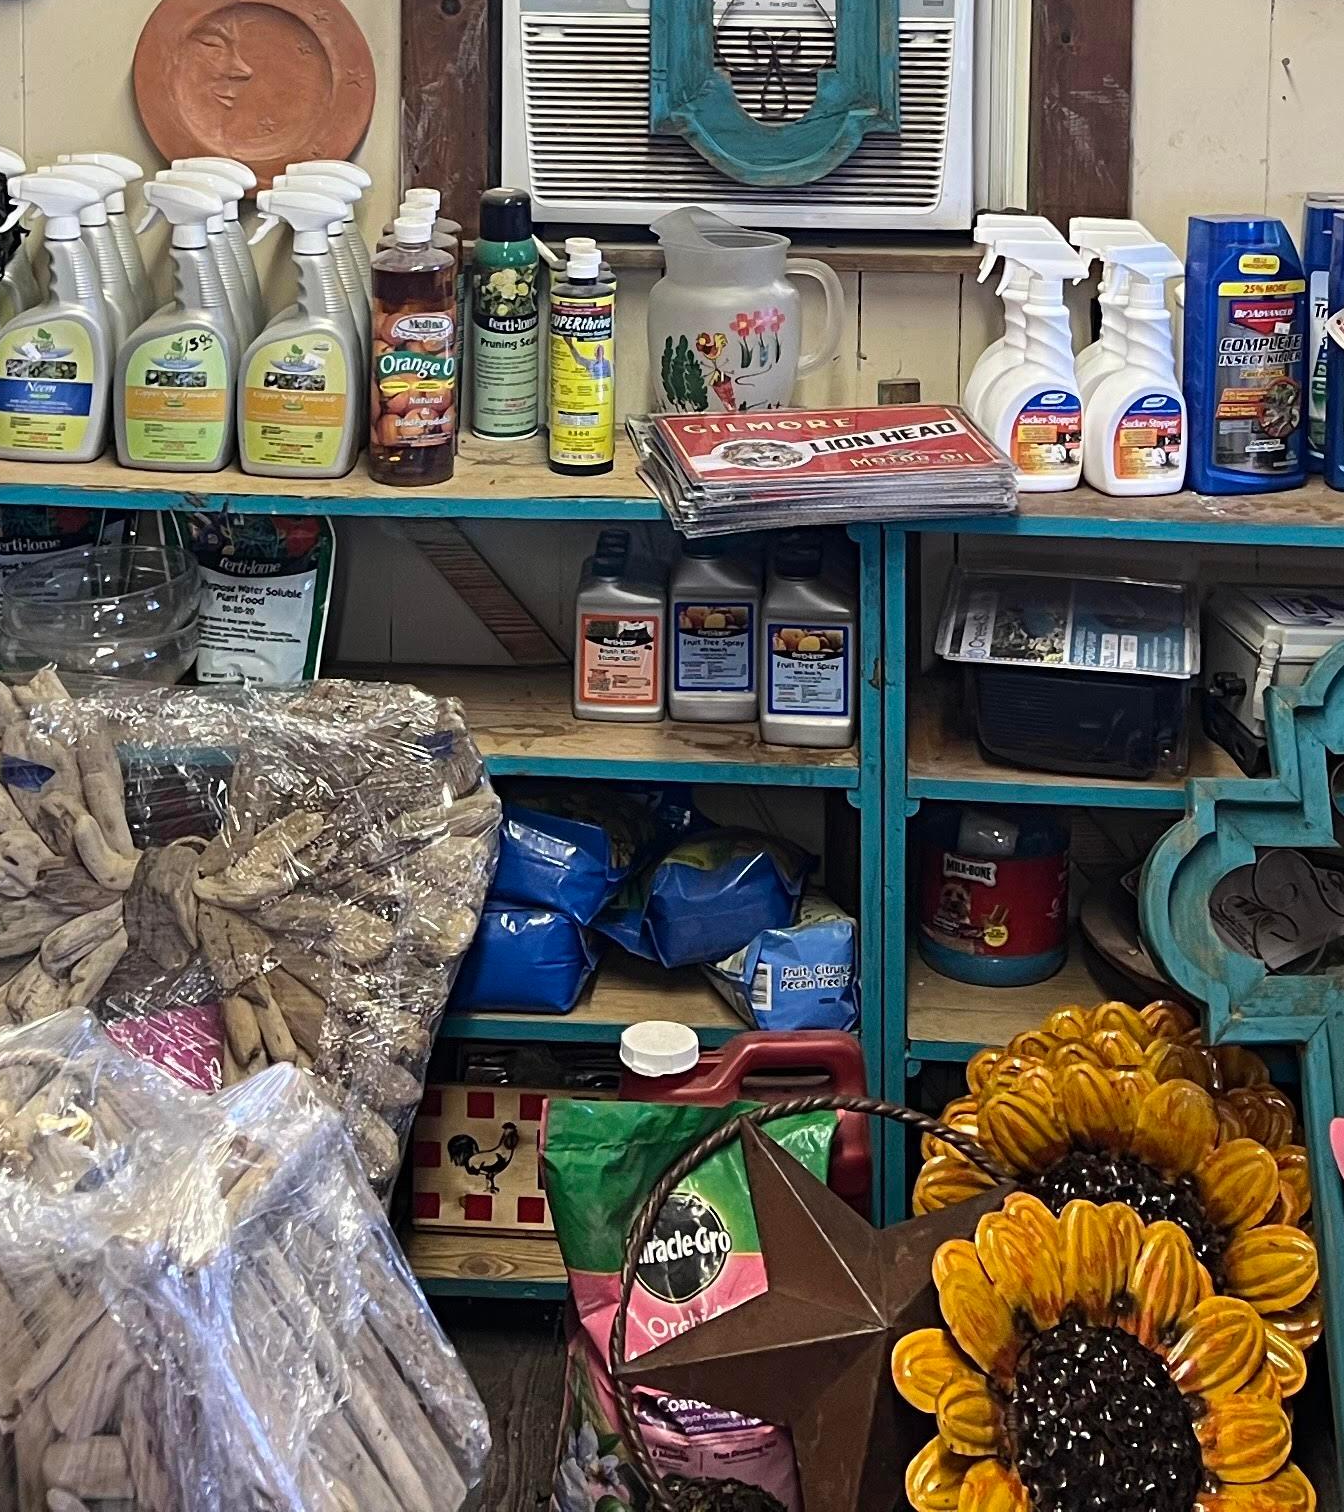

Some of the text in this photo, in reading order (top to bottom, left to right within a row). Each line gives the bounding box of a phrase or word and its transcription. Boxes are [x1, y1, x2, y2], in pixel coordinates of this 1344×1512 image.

[1243, 283, 1287, 294] 25% MORE
[408, 318, 444, 330] Medina
[480, 337, 517, 350] Pruning
[1219, 334, 1303, 353] COMPLETE
[1218, 350, 1302, 367] INSECT KILLER
[379, 354, 441, 379] Orange
[25, 381, 57, 393] Neem
[408, 395, 443, 405] Natural
[682, 415, 856, 435] GILMORE
[809, 420, 958, 454] LION HEAD
[849, 451, 978, 468] MOTOR OIL
[216, 593, 265, 606] Plant Food
[266, 587, 303, 599] Soluble
[683, 638, 745, 648] Fruit Tree Spray
[776, 661, 840, 671] Fruit Tree Spray
[945, 858, 992, 881] MILK-BONE
[782, 964, 846, 978] Fruit, Citrus
[780, 977, 841, 991] Pecan Tree
